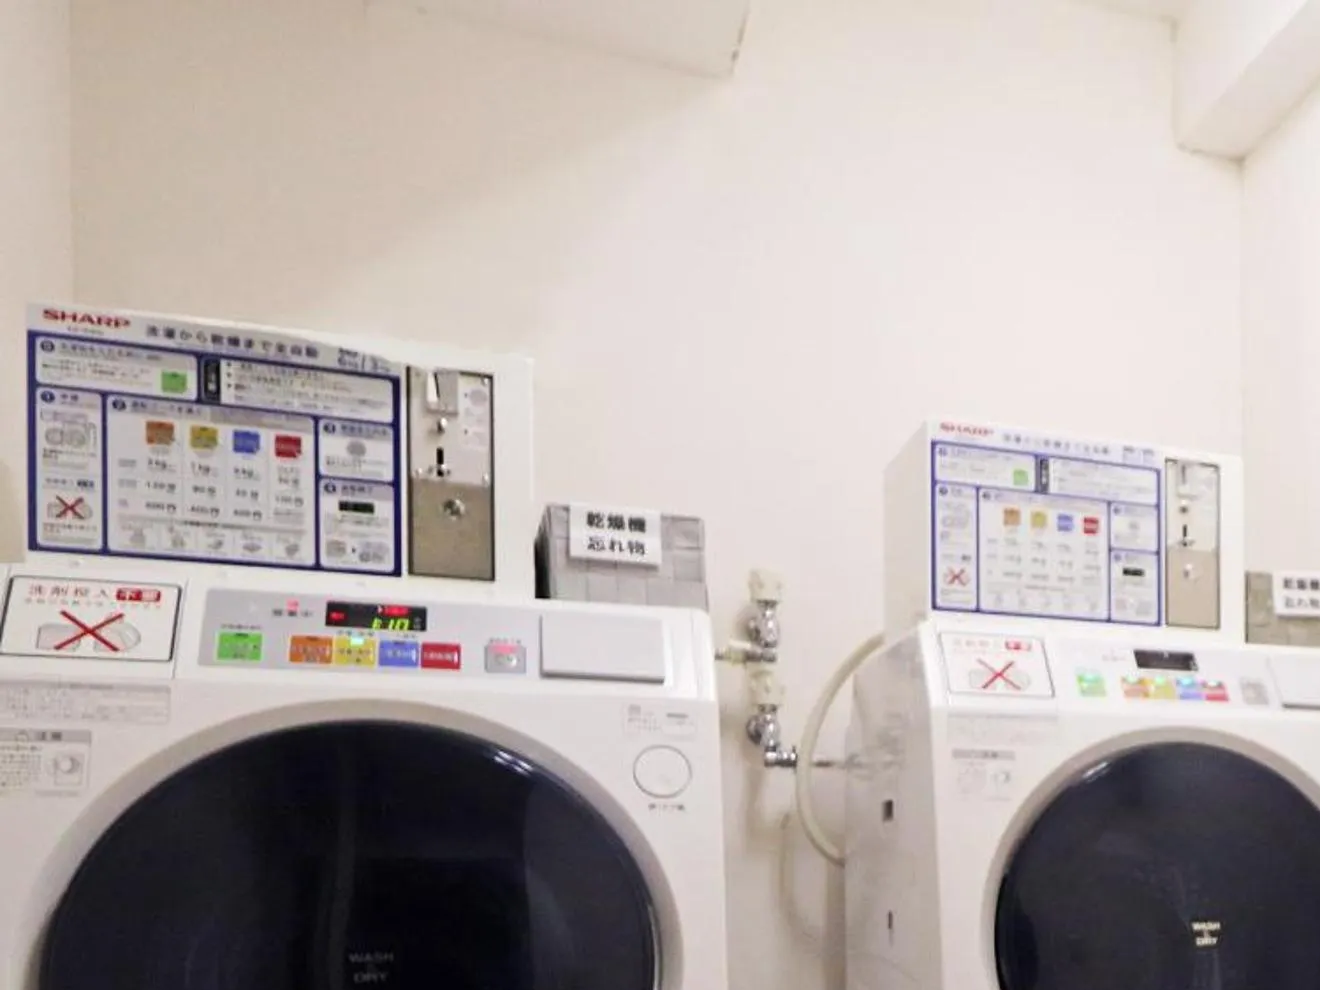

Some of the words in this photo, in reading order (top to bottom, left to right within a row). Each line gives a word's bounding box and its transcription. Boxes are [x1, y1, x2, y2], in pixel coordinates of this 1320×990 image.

[43, 308, 131, 329] SHARP
[587, 511, 646, 533] 乾燥機
[587, 536, 645, 555] 忘れ物
[349, 951, 394, 964] WASH
[353, 971, 389, 984] DRY
